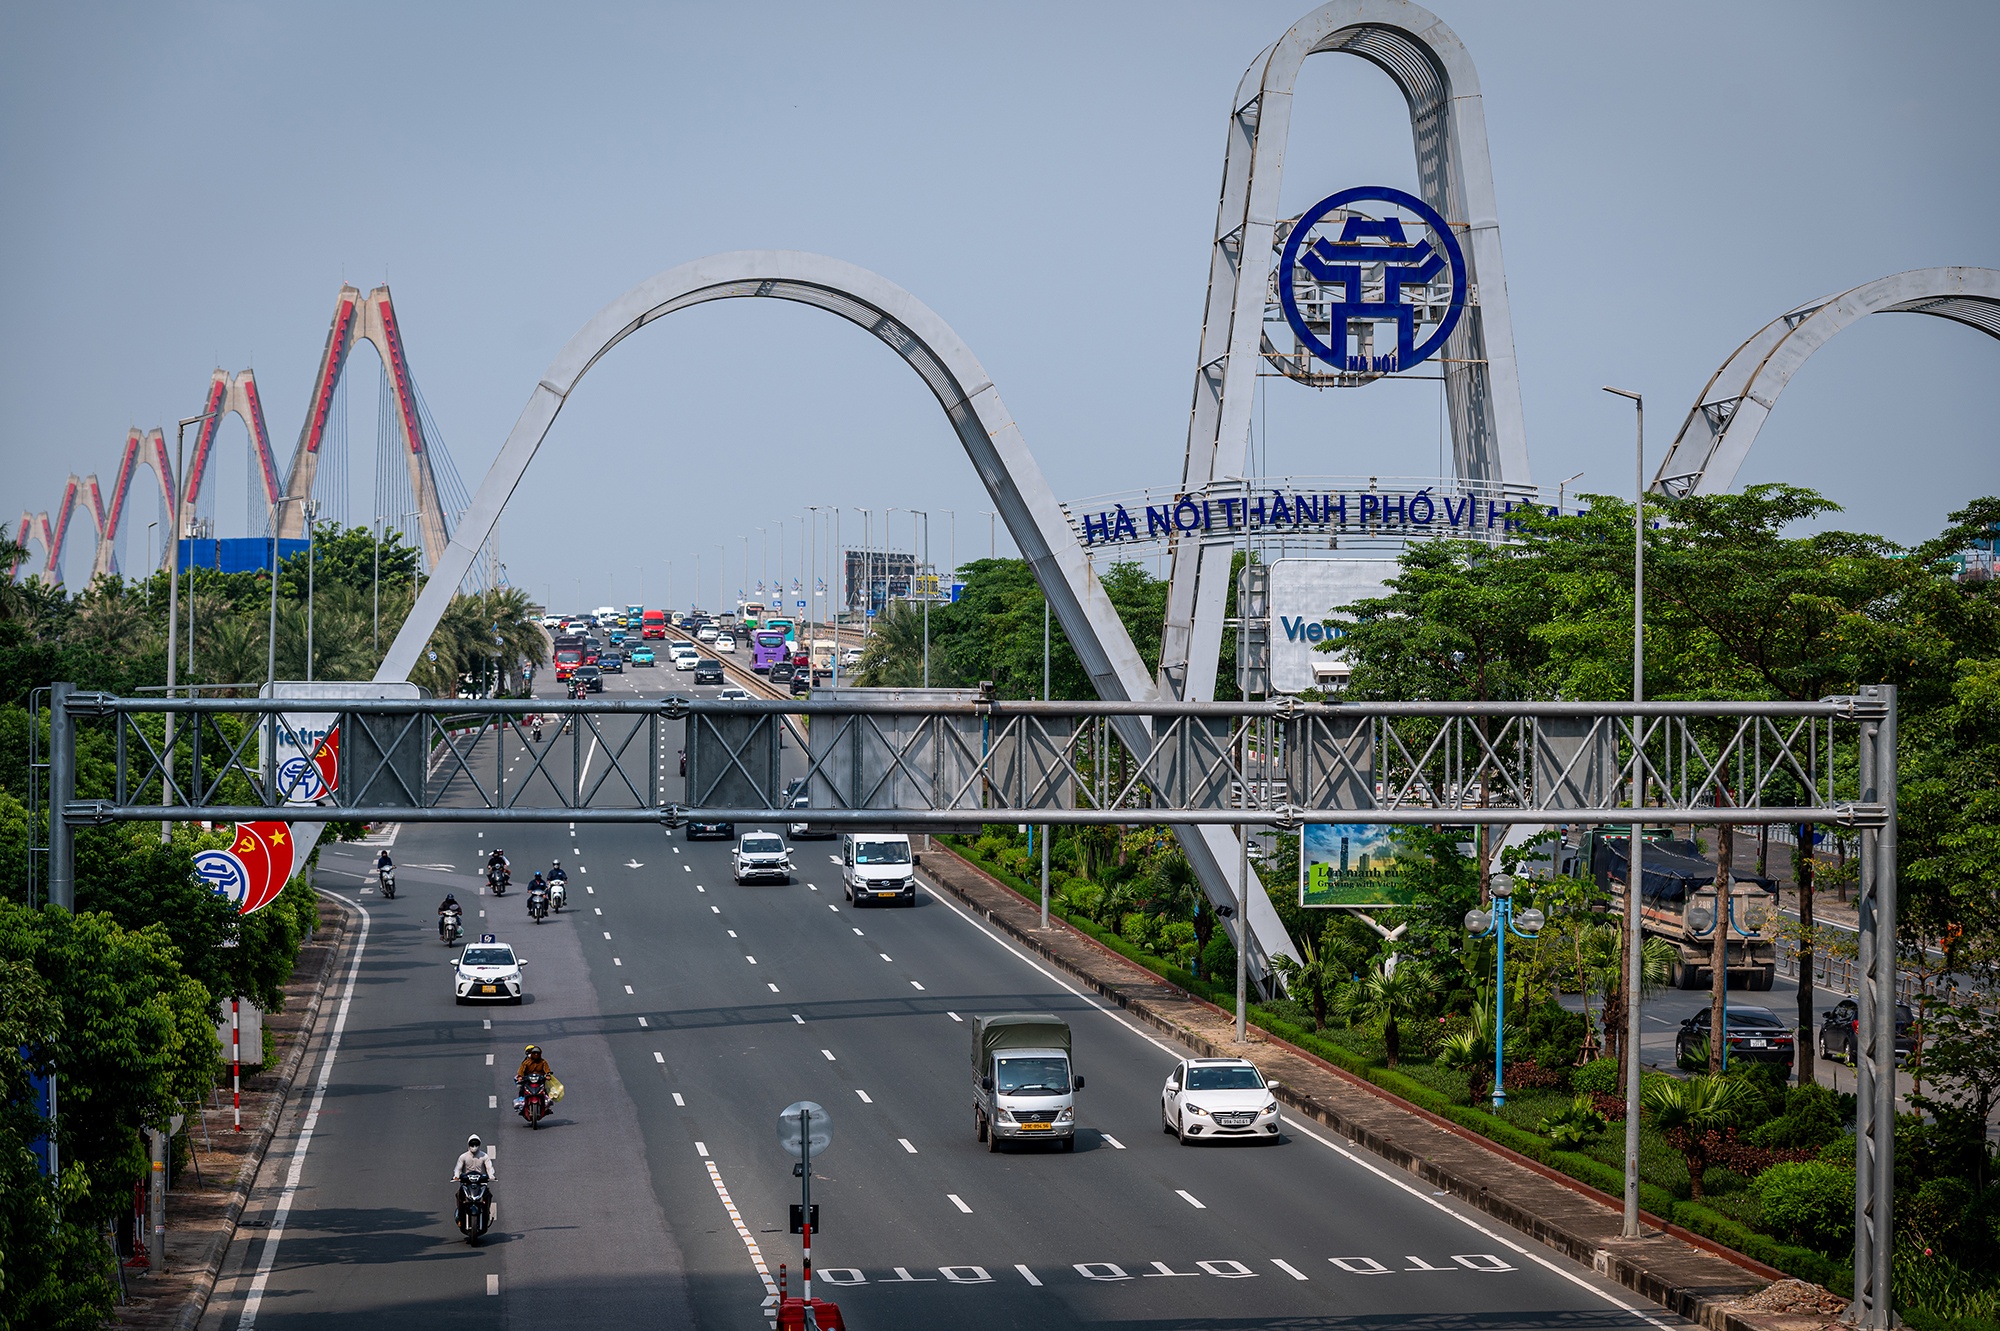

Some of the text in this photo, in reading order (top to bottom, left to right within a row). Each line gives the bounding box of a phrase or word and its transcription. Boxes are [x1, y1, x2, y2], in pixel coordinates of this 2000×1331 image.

[1083, 503, 1138, 545] HÀ
[1146, 496, 1211, 538] NỘI
[1218, 490, 1346, 528] THÀNH
[1360, 487, 1435, 525] PHỐ
[1443, 493, 1476, 528] VÌ
[1317, 880, 1355, 889] Growing
[1356, 880, 1375, 888] with
